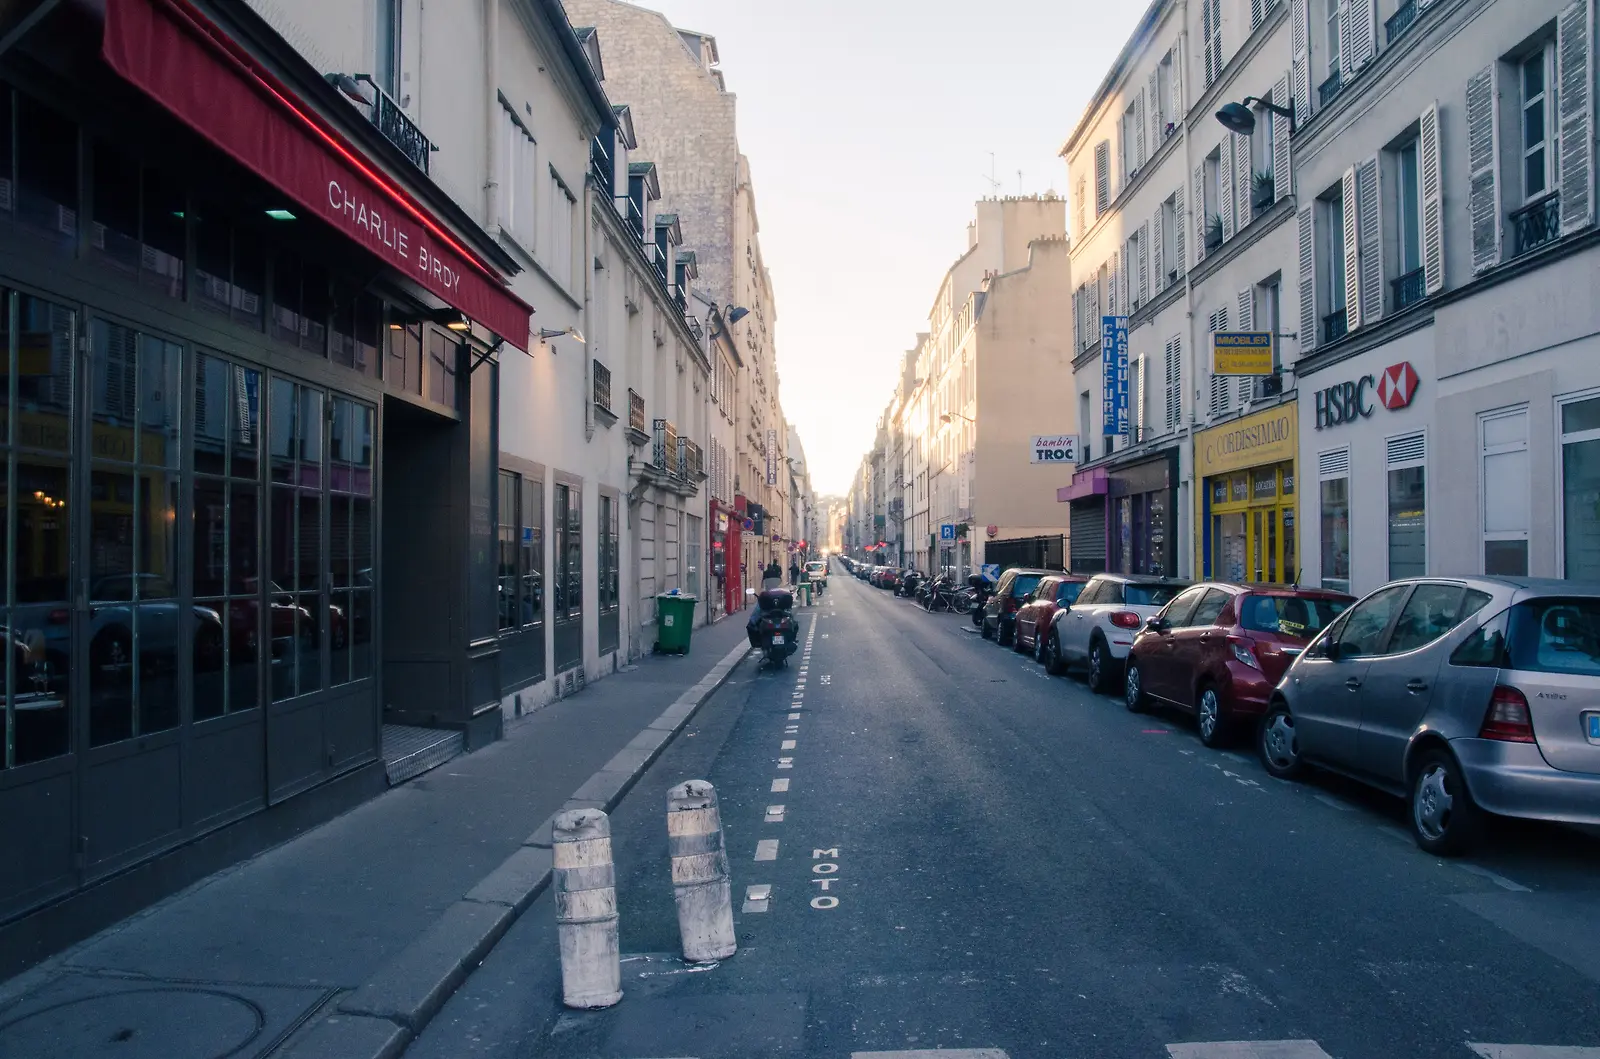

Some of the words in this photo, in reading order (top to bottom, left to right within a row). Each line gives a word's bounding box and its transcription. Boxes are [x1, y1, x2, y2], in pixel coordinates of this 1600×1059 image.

[328, 180, 408, 259] CHARLIE
[418, 246, 460, 293] BIRDY
[1216, 335, 1268, 345] IMMOBILIER
[1103, 323, 1114, 426] COIFFURE
[1115, 317, 1128, 433] MASCULINE
[1314, 374, 1375, 431] HSBC
[1036, 437, 1073, 447] bambin
[1036, 449, 1073, 460] TROC
[1216, 416, 1290, 456] CORDISSIMMO
[944, 527, 951, 537] P
[810, 848, 839, 909] MOTO
